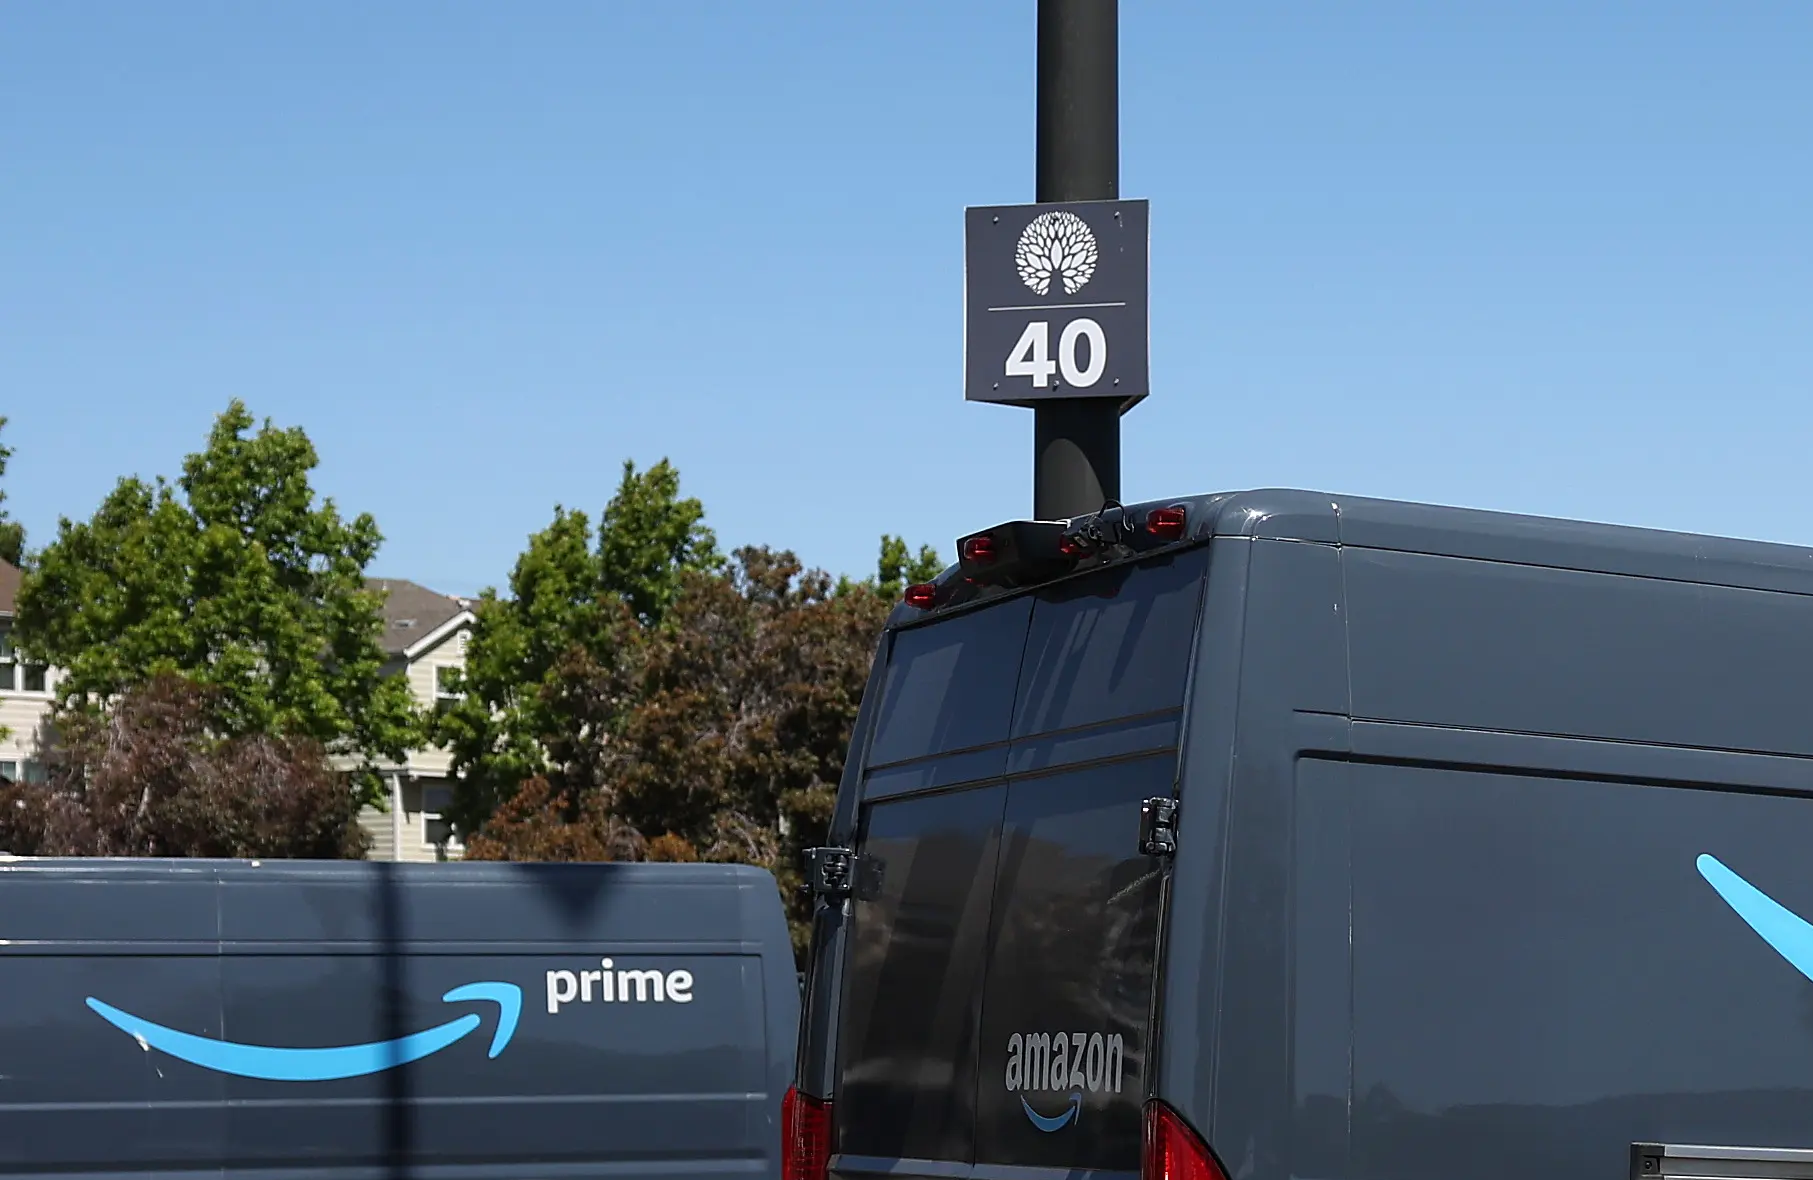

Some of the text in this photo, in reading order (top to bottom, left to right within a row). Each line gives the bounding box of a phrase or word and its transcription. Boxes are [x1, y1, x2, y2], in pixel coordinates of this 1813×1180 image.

[1005, 317, 1108, 388] 40
[546, 957, 694, 1014] prime
[1005, 1031, 1124, 1093] amazon
